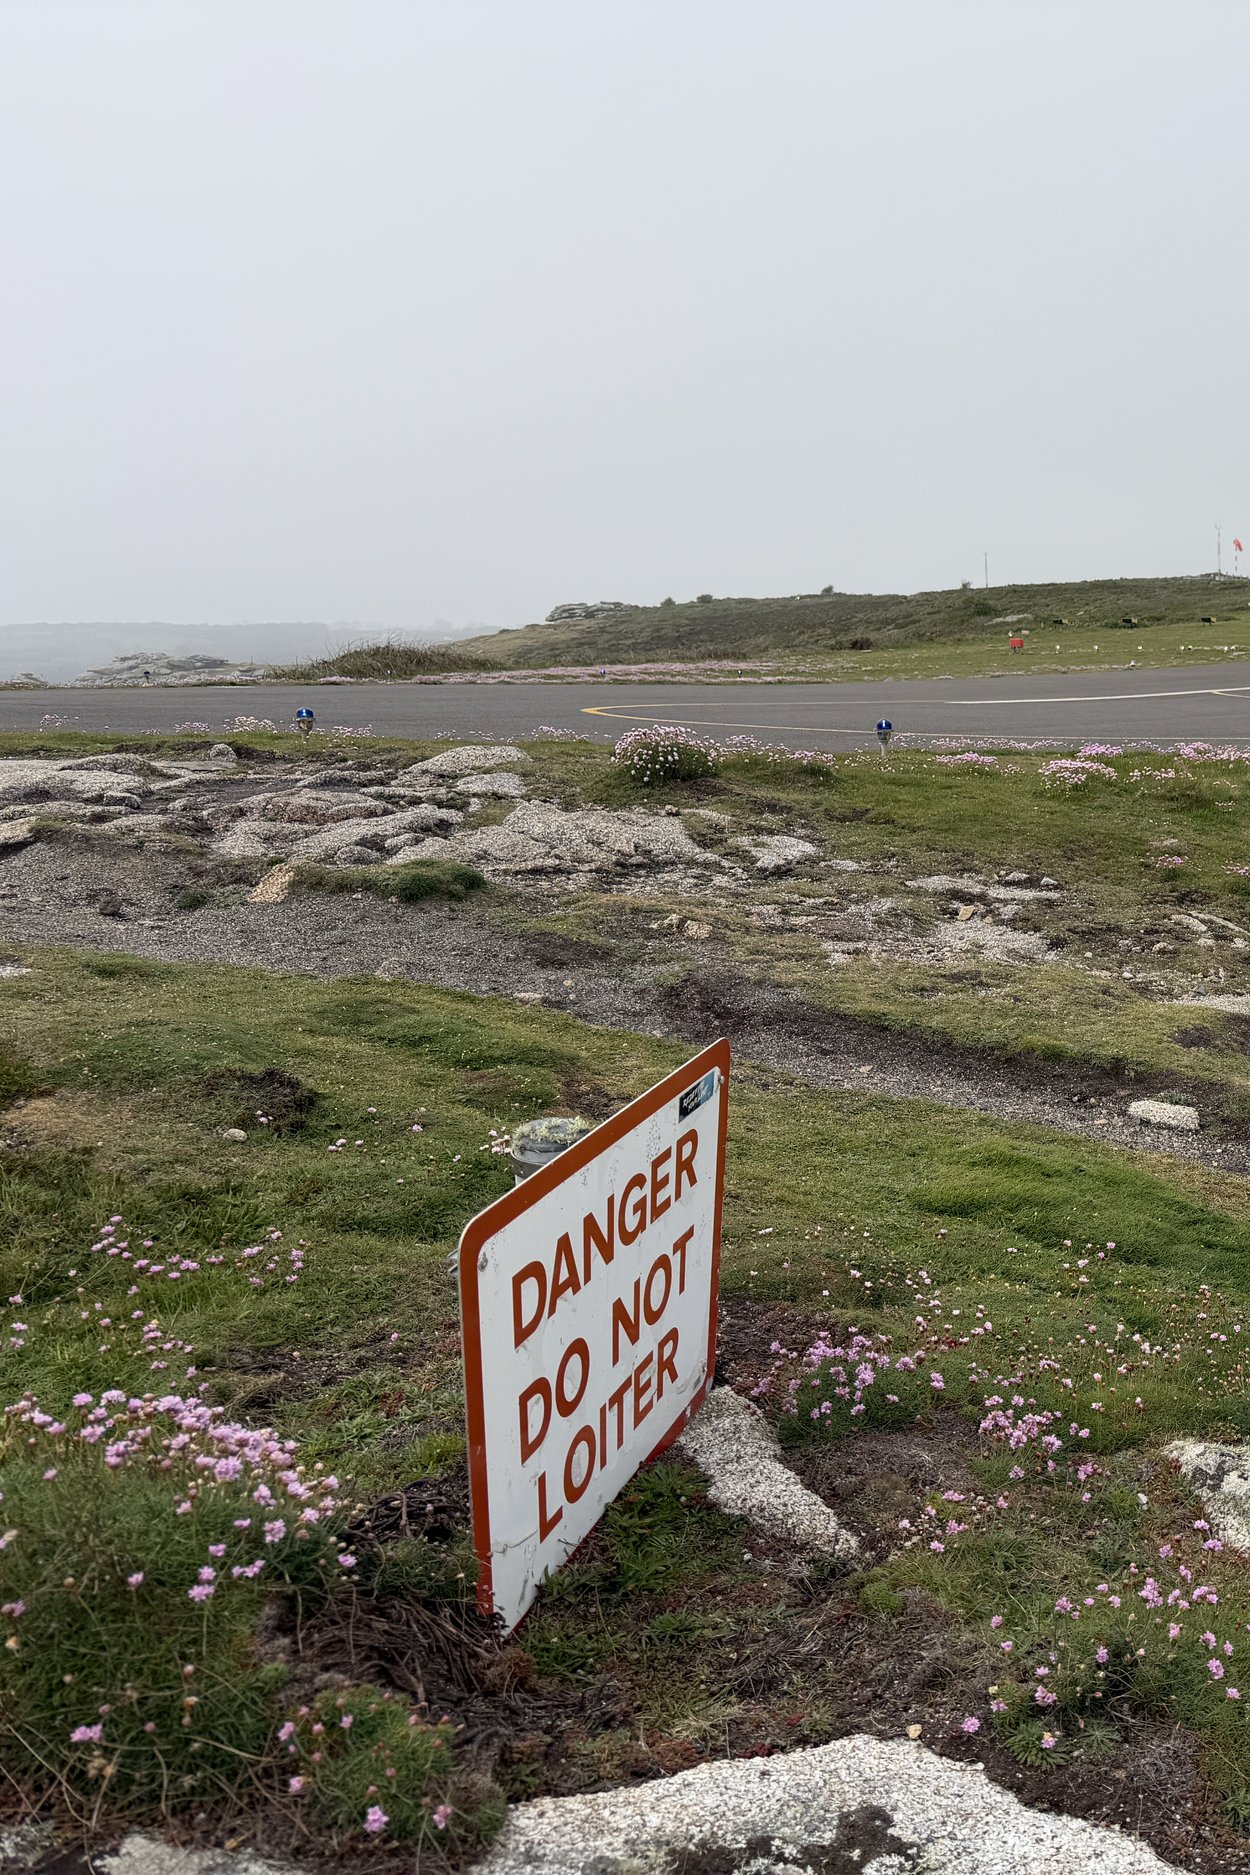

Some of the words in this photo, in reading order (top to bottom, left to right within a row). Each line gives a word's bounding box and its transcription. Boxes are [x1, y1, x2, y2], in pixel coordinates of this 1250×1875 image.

[512, 1128, 699, 1349] DANGER
[519, 1337, 590, 1465] DO
[611, 1225, 695, 1367] NOT
[538, 1327, 679, 1544] LOITER
